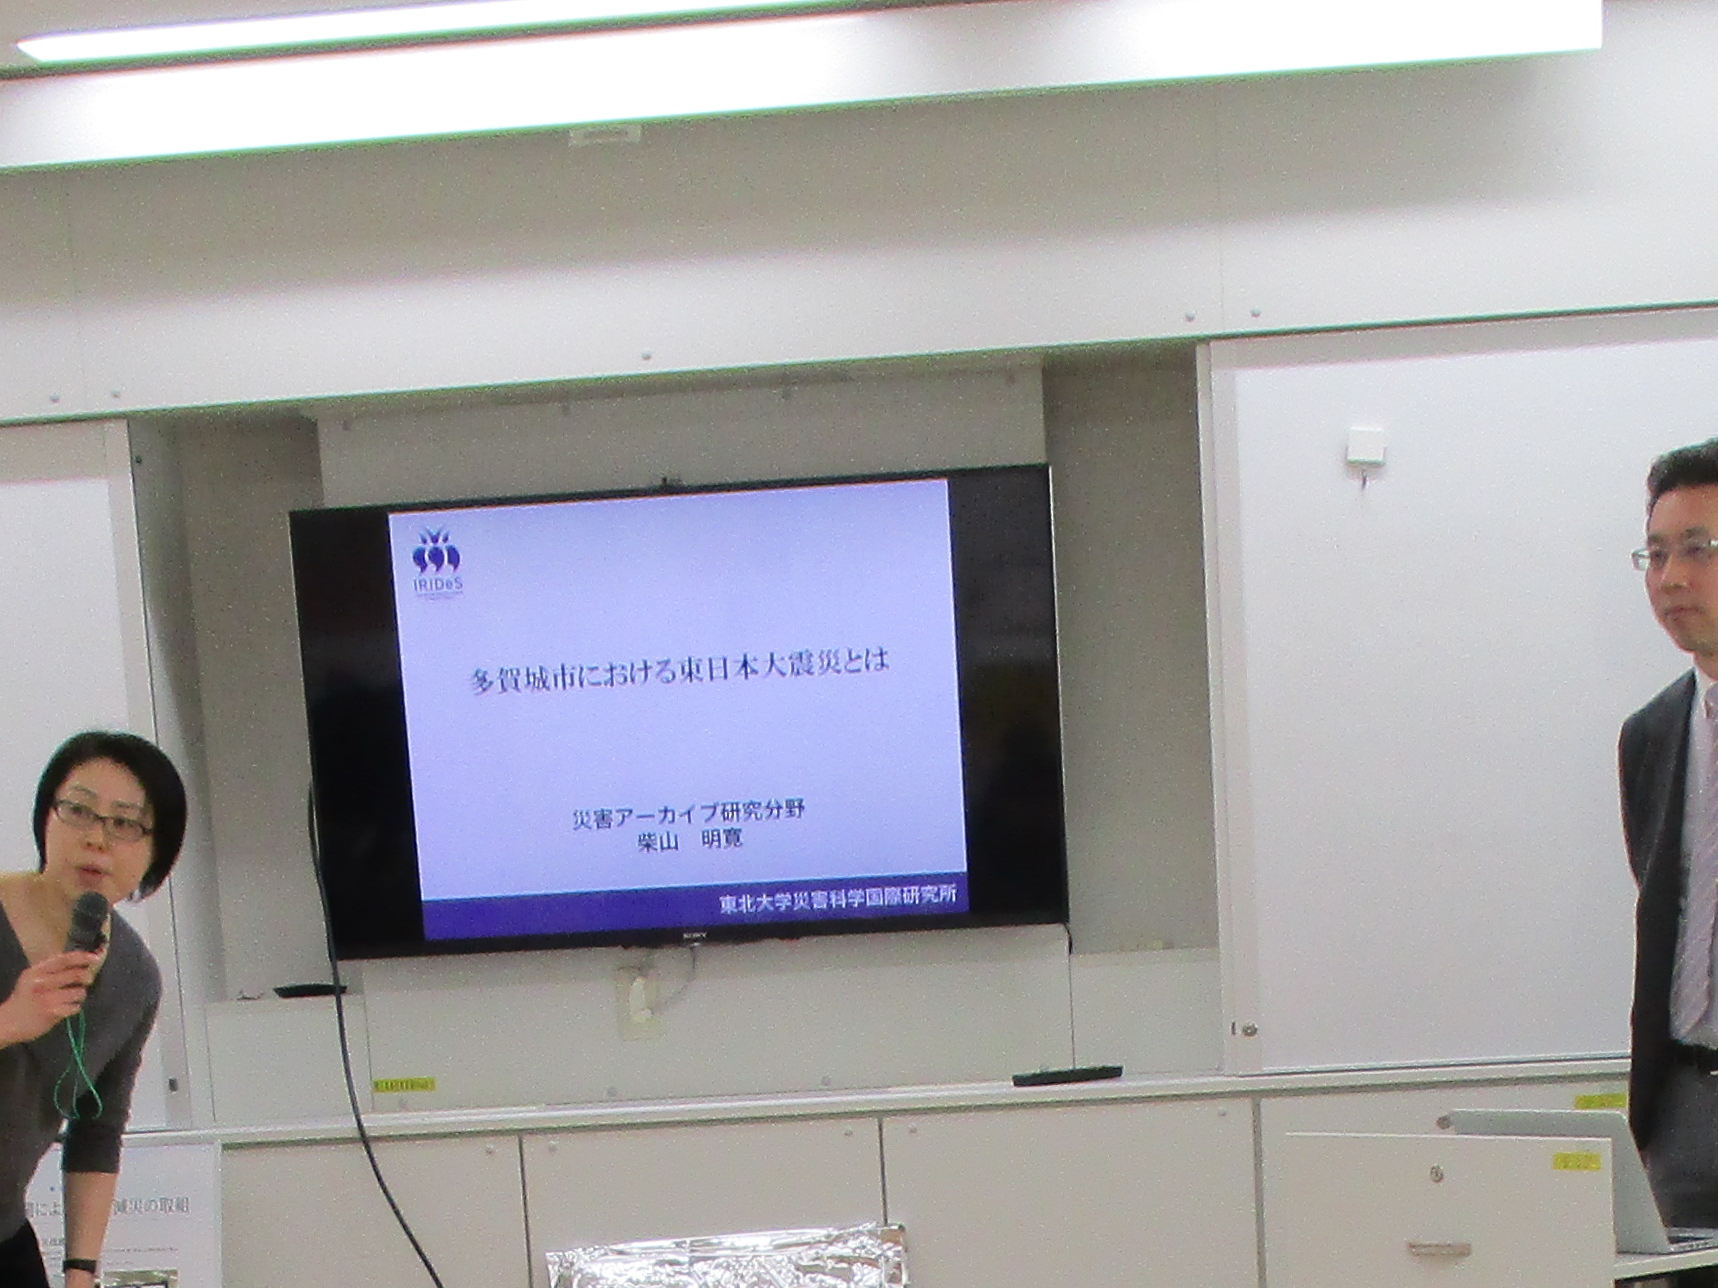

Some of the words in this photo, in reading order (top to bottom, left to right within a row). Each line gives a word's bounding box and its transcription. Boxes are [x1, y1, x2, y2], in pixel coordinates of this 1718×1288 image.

[413, 577, 463, 592] IRIDeS
[472, 646, 890, 696] 多賀城市における東日本大震災とは
[572, 797, 806, 831] 災害アーカイブ研究分野
[718, 883, 958, 915] 東北大学災害科学国際研究所
